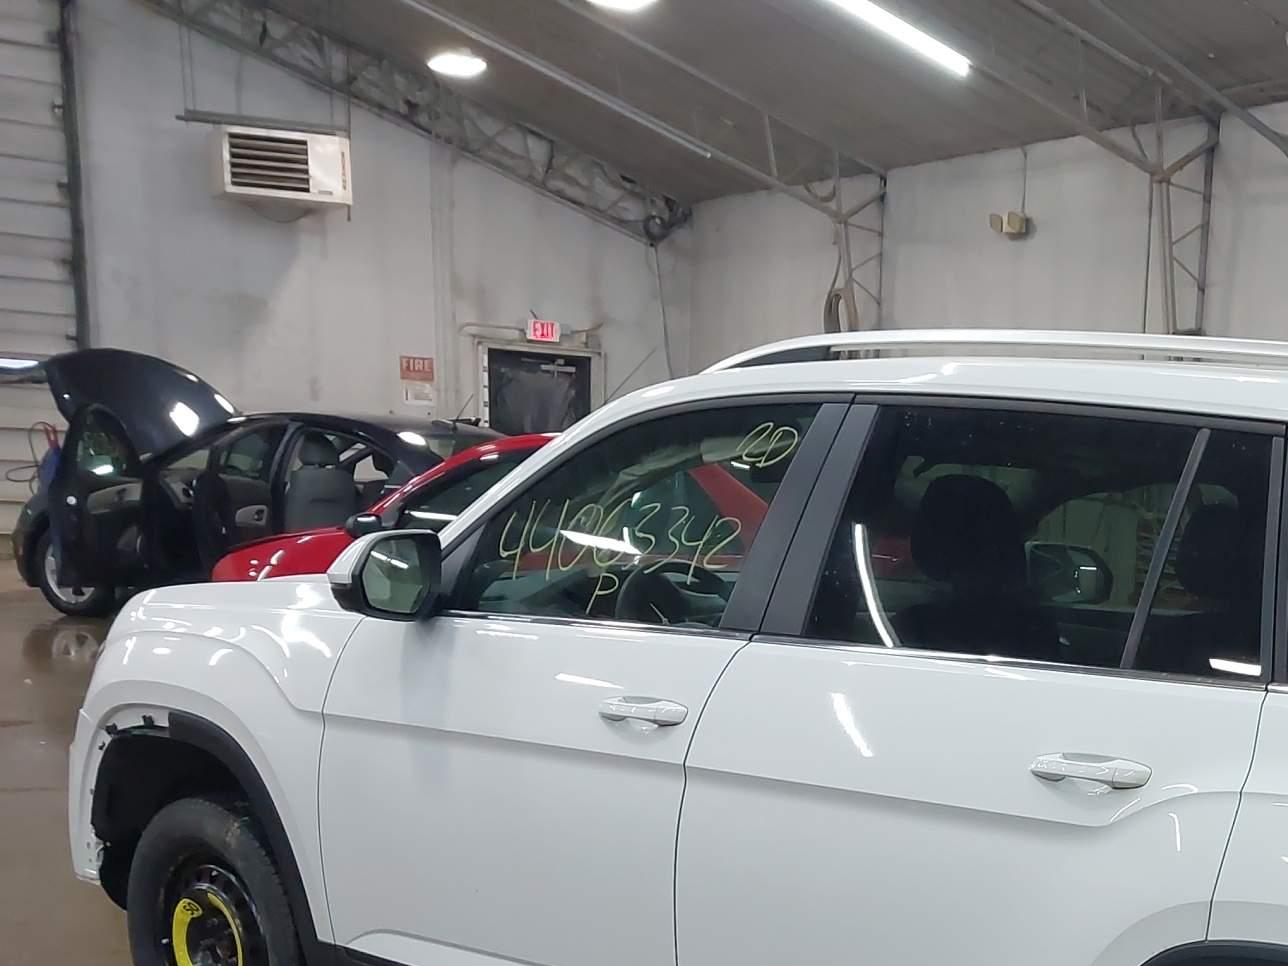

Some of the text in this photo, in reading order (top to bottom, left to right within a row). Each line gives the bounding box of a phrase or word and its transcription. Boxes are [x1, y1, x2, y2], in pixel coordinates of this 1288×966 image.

[532, 320, 556, 339] EXIT
[401, 358, 433, 373] FIRE
[585, 571, 619, 615] P
